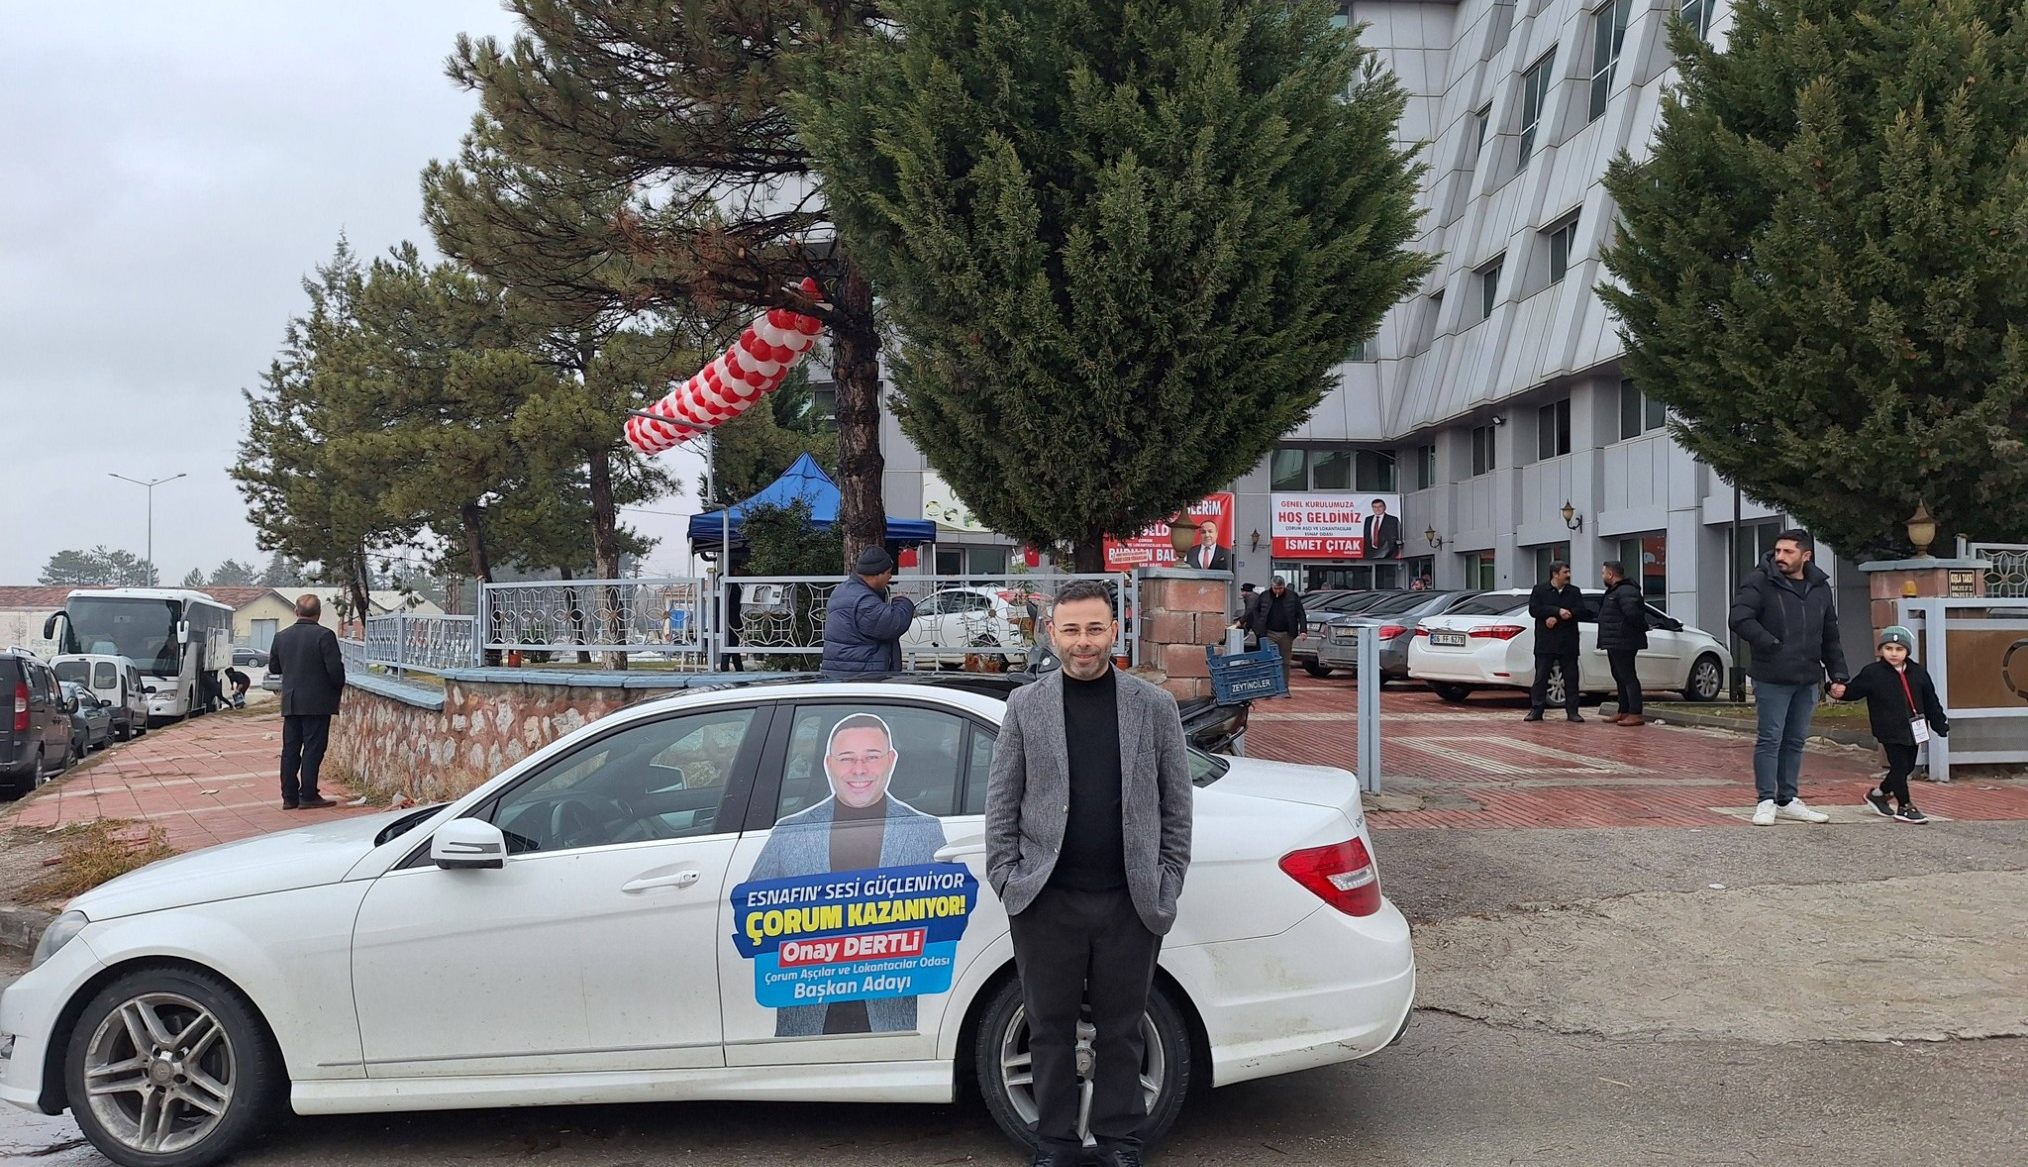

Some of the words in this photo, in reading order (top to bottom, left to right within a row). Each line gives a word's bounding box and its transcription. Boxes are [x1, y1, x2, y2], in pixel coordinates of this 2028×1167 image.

[1278, 512, 1302, 526] HOŞ
[1307, 509, 1362, 524] GELDİNİZ
[1285, 538, 1322, 550] İSMET
[1326, 540, 1360, 553] ÇITAK
[824, 877, 860, 900] SESİ
[863, 873, 965, 899] GÜÇLENİYOR
[746, 904, 842, 945] ÇORUM
[848, 895, 966, 927] KAZANIYOR!
[782, 941, 840, 963] Onay
[765, 971, 798, 984] Çorum
[800, 967, 835, 982] Aşçılar
[838, 967, 850, 976] ve
[853, 959, 917, 974] Lokantacılar
[920, 956, 950, 969] Odası
[794, 979, 857, 1003] Başkan
[862, 976, 911, 996] Adayı
